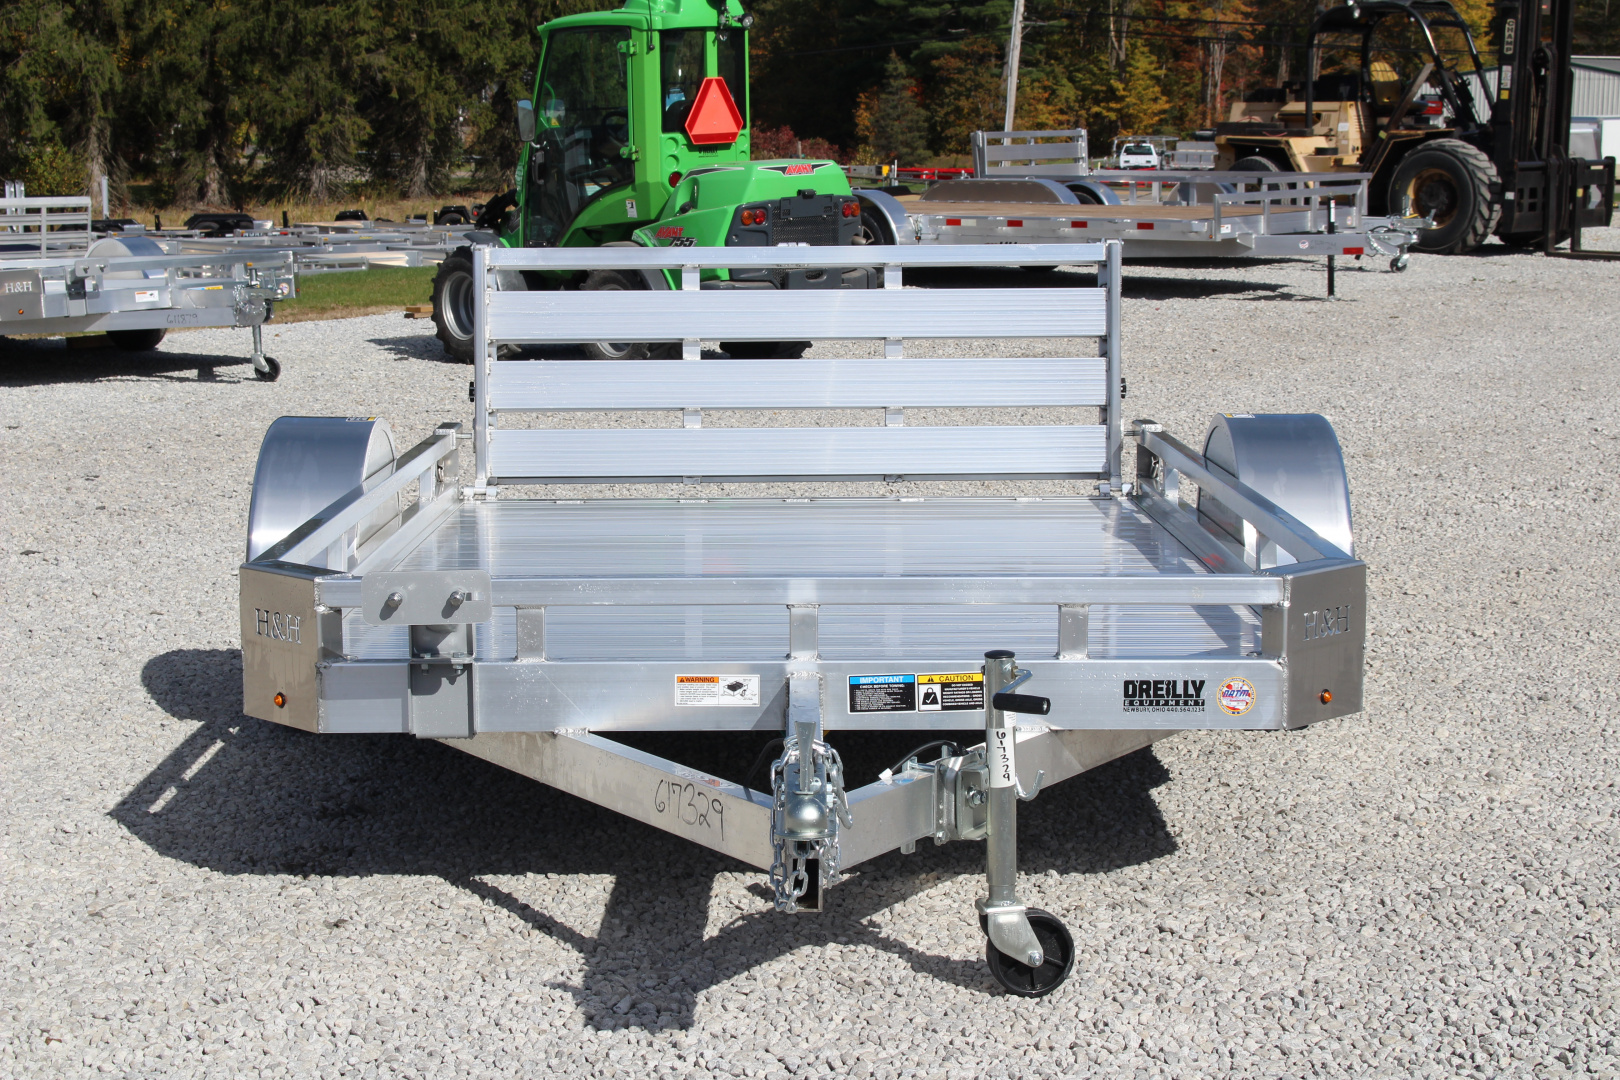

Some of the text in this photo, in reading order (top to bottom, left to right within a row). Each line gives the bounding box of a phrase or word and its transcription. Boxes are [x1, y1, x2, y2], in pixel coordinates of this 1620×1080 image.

[1505, 20, 1514, 53] CHAMP
[785, 163, 813, 175] AVANT
[654, 226, 684, 238] AVANT
[668, 236, 697, 247] 755
[5, 281, 32, 293] H&H
[254, 607, 301, 645] H&H
[1303, 605, 1351, 641] H&H
[860, 675, 904, 684] IMPORTANT
[938, 674, 974, 682] CAUTION
[655, 779, 724, 841] 617329
